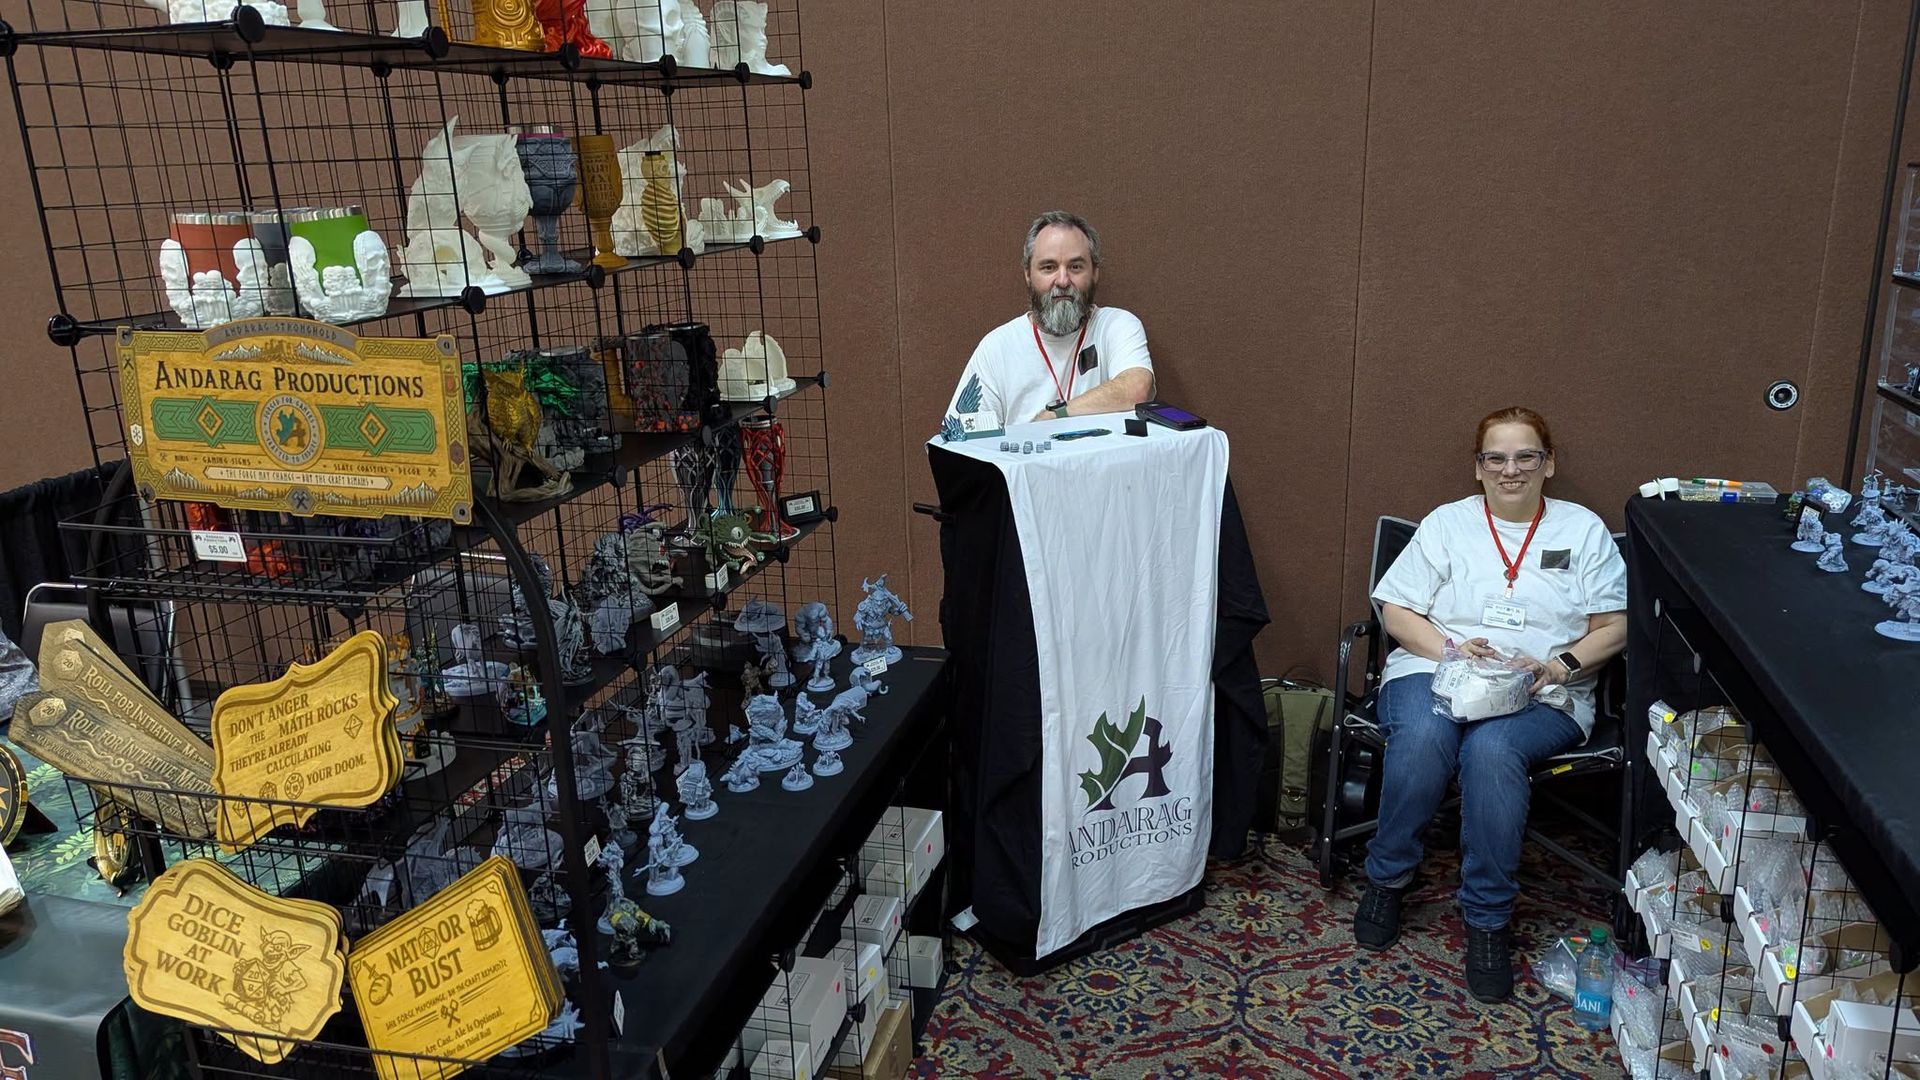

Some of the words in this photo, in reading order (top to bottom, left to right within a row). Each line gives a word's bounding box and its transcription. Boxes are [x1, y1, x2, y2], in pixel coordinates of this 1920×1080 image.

[154, 360, 262, 391] ANDARAG
[273, 367, 424, 398] PRODUCTIONS
[82, 665, 112, 697] ROLL
[111, 692, 134, 717] FOR
[64, 708, 101, 737] ROLL
[99, 729, 124, 751] FOR
[230, 711, 265, 737] DON'T
[268, 693, 309, 722] ANGER
[249, 730, 266, 744] THE
[279, 712, 315, 738] MATH
[317, 693, 359, 725] ROCKS
[229, 752, 267, 773] THEY'RE
[268, 732, 309, 758] ALREADY
[266, 740, 332, 775] CALCULATING
[306, 766, 333, 785] YOUR
[335, 753, 367, 774] DOOM.
[1071, 822, 1193, 870] RODUCTIONS
[182, 893, 245, 935] DICE
[167, 913, 246, 959] GOBLIN
[184, 943, 213, 964] AT
[385, 937, 420, 975] NAT
[437, 913, 466, 943] OR
[156, 949, 227, 996] WORK
[407, 947, 464, 999] BUST
[1574, 991, 1601, 1013] SANI
[455, 1027, 466, 1040] Ale
